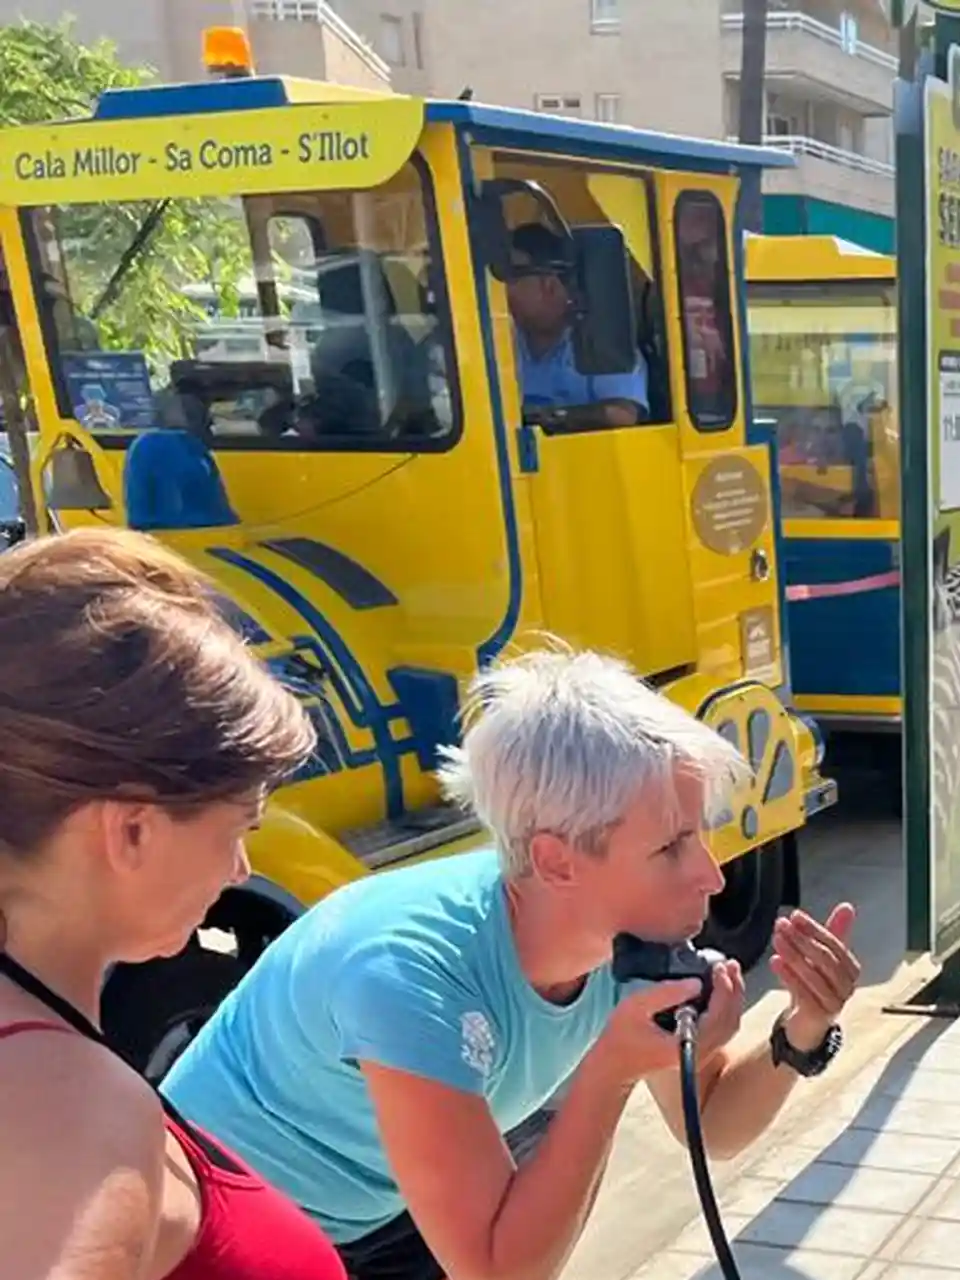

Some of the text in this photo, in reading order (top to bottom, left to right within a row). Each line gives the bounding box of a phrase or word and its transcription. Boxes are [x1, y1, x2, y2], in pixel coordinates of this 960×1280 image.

[15, 150, 66, 180] Cala
[73, 146, 141, 177] Millor
[165, 142, 192, 172] Sa
[199, 139, 272, 169] Coma
